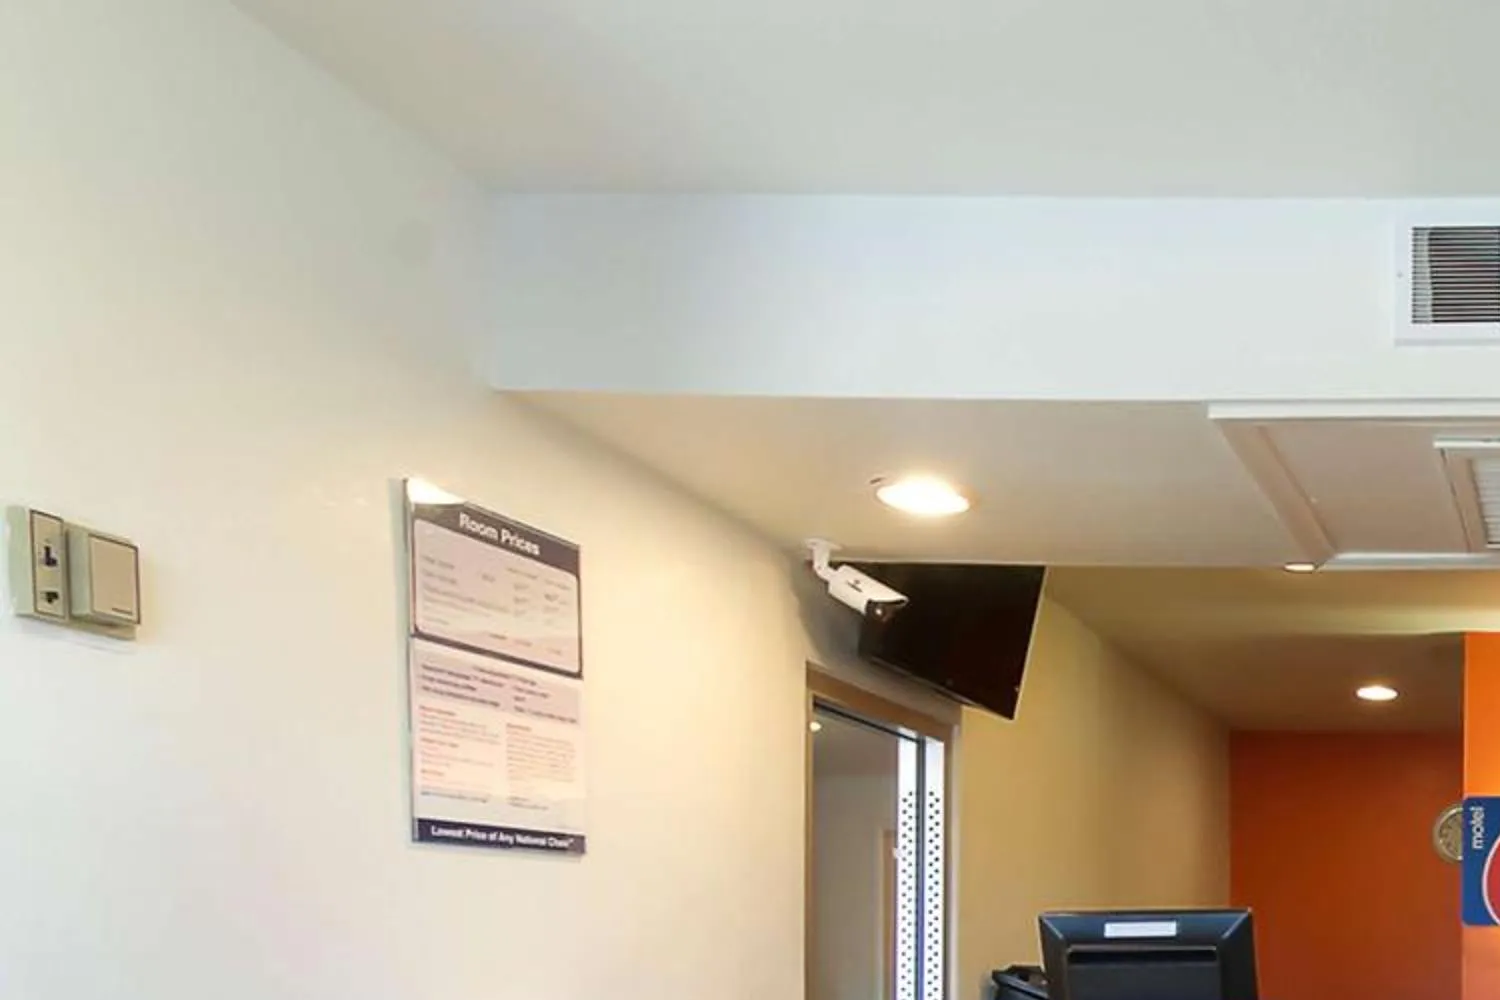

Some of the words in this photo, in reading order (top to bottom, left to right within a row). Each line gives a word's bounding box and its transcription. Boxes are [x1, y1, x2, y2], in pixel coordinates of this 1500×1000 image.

[459, 512, 498, 540] Room
[501, 528, 540, 555] Prices
[465, 828, 487, 840] Price
[489, 831, 498, 842] of
[499, 832, 514, 845] Any
[1469, 806, 1485, 849] motel
